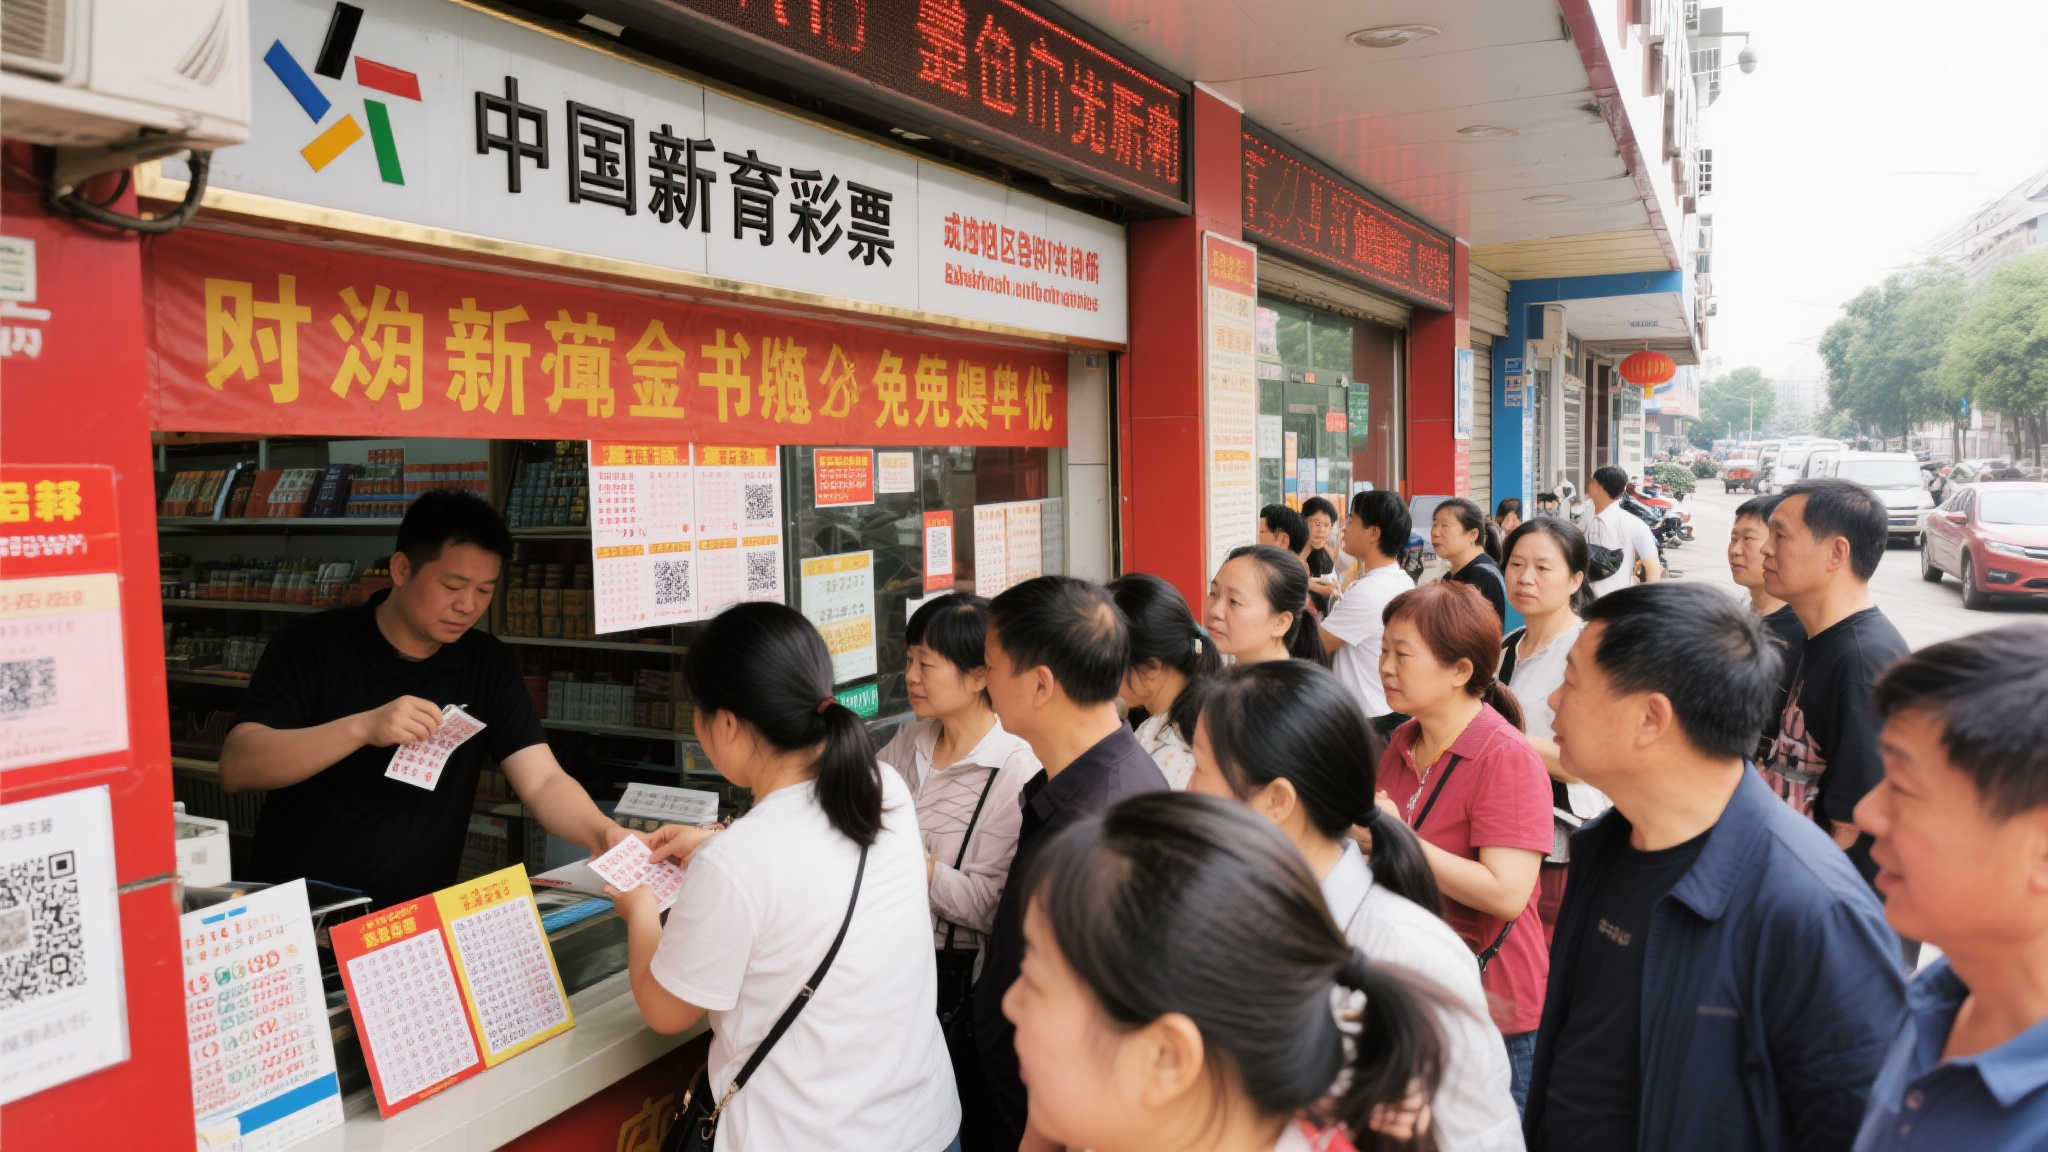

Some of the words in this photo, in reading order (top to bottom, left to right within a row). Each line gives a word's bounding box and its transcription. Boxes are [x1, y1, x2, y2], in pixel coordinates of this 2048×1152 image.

[475, 75, 895, 268] 中国新育彩票
